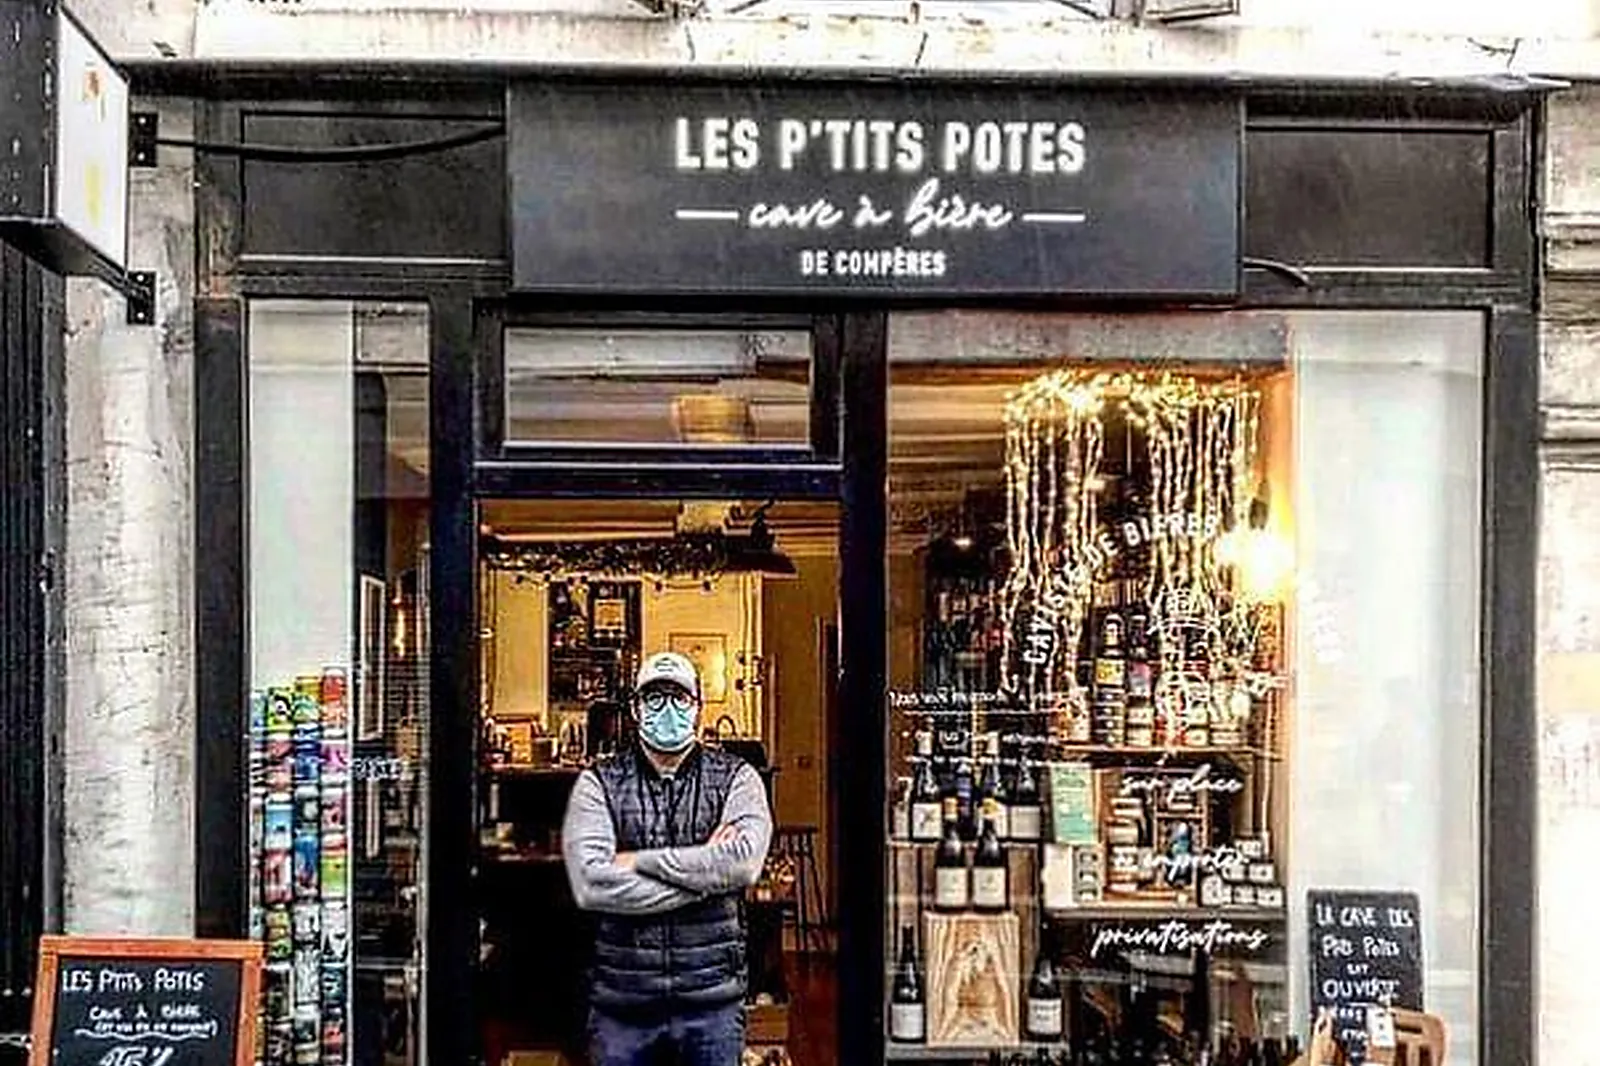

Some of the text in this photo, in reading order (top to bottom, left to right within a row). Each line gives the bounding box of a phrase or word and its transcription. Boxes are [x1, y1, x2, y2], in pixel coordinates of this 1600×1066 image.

[674, 117, 1087, 174] LES P'TITS POTES
[749, 177, 1012, 237] cave à bière
[801, 246, 947, 277] DE COMPÈRES
